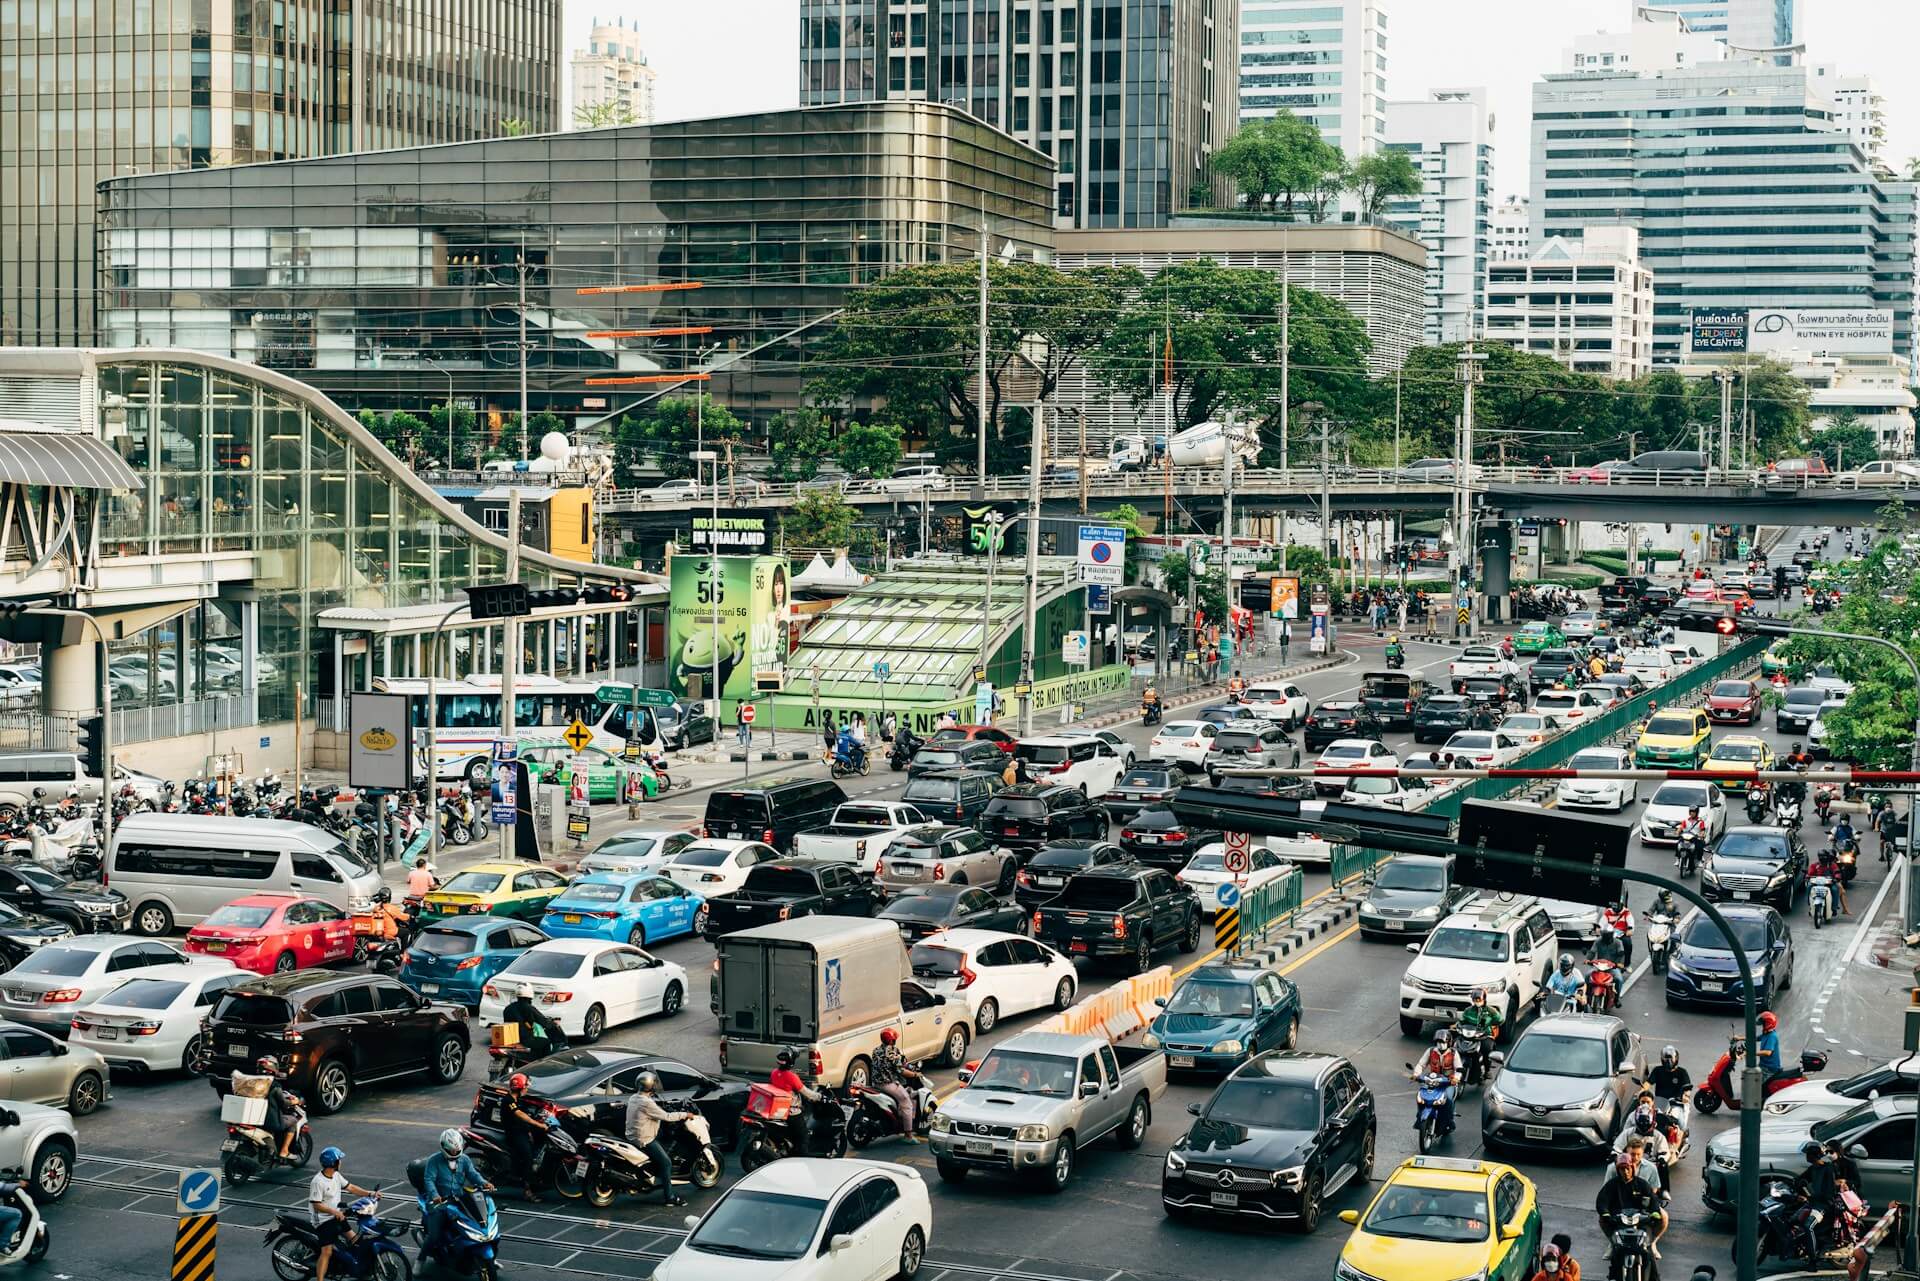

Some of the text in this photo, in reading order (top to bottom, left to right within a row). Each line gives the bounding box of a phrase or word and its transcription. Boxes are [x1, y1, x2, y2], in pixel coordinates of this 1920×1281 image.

[1694, 338, 1710, 347] EYE
[716, 518, 766, 530] NETWORK
[692, 531, 766, 546] IN THAILAND
[708, 570, 725, 579] AS
[755, 576, 765, 591] 5G
[697, 580, 725, 605] 5G
[736, 607, 747, 617] 5G
[1036, 690, 1044, 707] 5G
[1047, 687, 1060, 705] NO.1
[1091, 677, 1098, 694] IN
[580, 776, 588, 785] 17
[504, 795, 513, 804] 13
